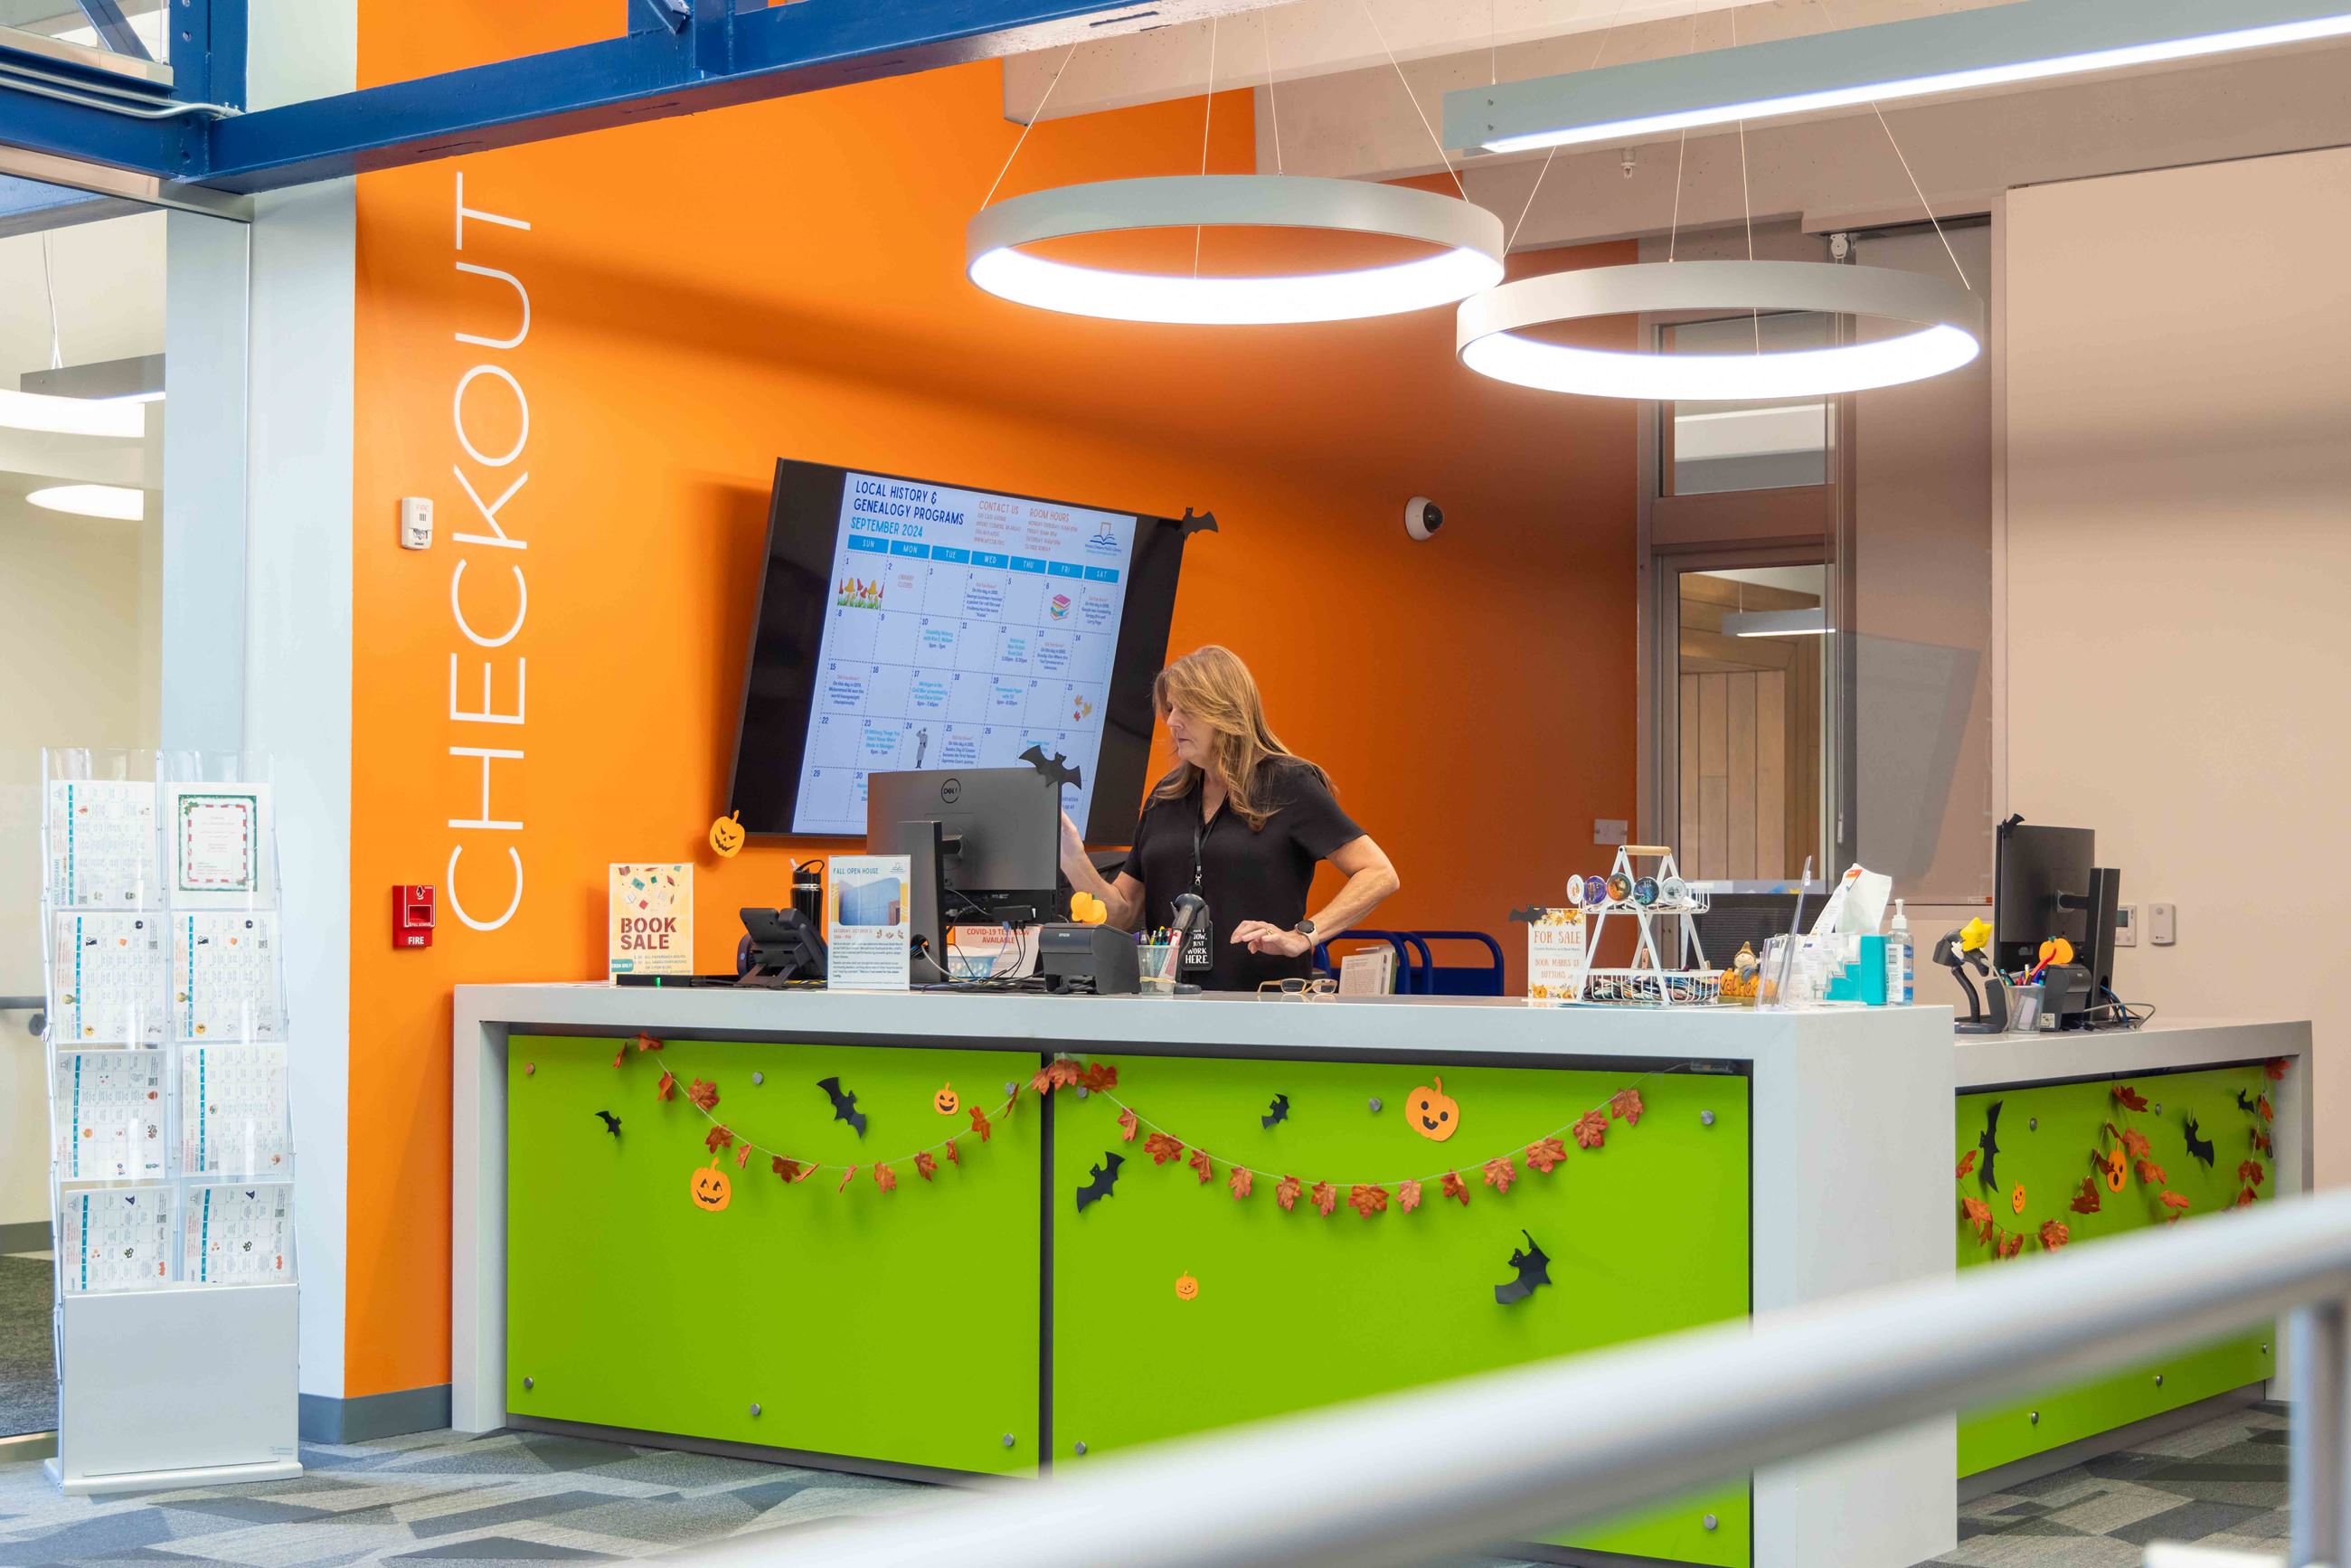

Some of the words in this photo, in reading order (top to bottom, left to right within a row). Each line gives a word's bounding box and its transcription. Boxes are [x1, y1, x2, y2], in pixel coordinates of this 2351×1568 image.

[856, 480, 886, 496] LOCAL
[891, 486, 928, 503] HISTORY
[931, 492, 937, 505] &
[854, 498, 911, 517] GENEALOGY
[914, 506, 964, 524] PROGRAMS
[978, 500, 1009, 514] CONTACT
[1011, 506, 1019, 515] US
[1029, 508, 1048, 519] ROOM
[1049, 511, 1070, 522] HOURS
[851, 517, 899, 535] SEPTEMBER
[902, 524, 922, 537] 2024
[447, 172, 532, 932] CHECKOUT
[863, 539, 874, 548] SUN
[902, 544, 917, 553] MON
[946, 550, 956, 559] TUE
[984, 555, 996, 564] WED
[1023, 561, 1034, 569] THU
[1096, 571, 1107, 579] SAT
[955, 673, 960, 681] 18
[620, 917, 676, 933] BOOK
[620, 934, 669, 950] SALE
[1534, 931, 1553, 943] FOR
[1559, 931, 1581, 943] SALE
[1185, 955, 1209, 964] HERE.
[1552, 959, 1571, 967] MARKS
[1541, 970, 1565, 978] BUTTONS
